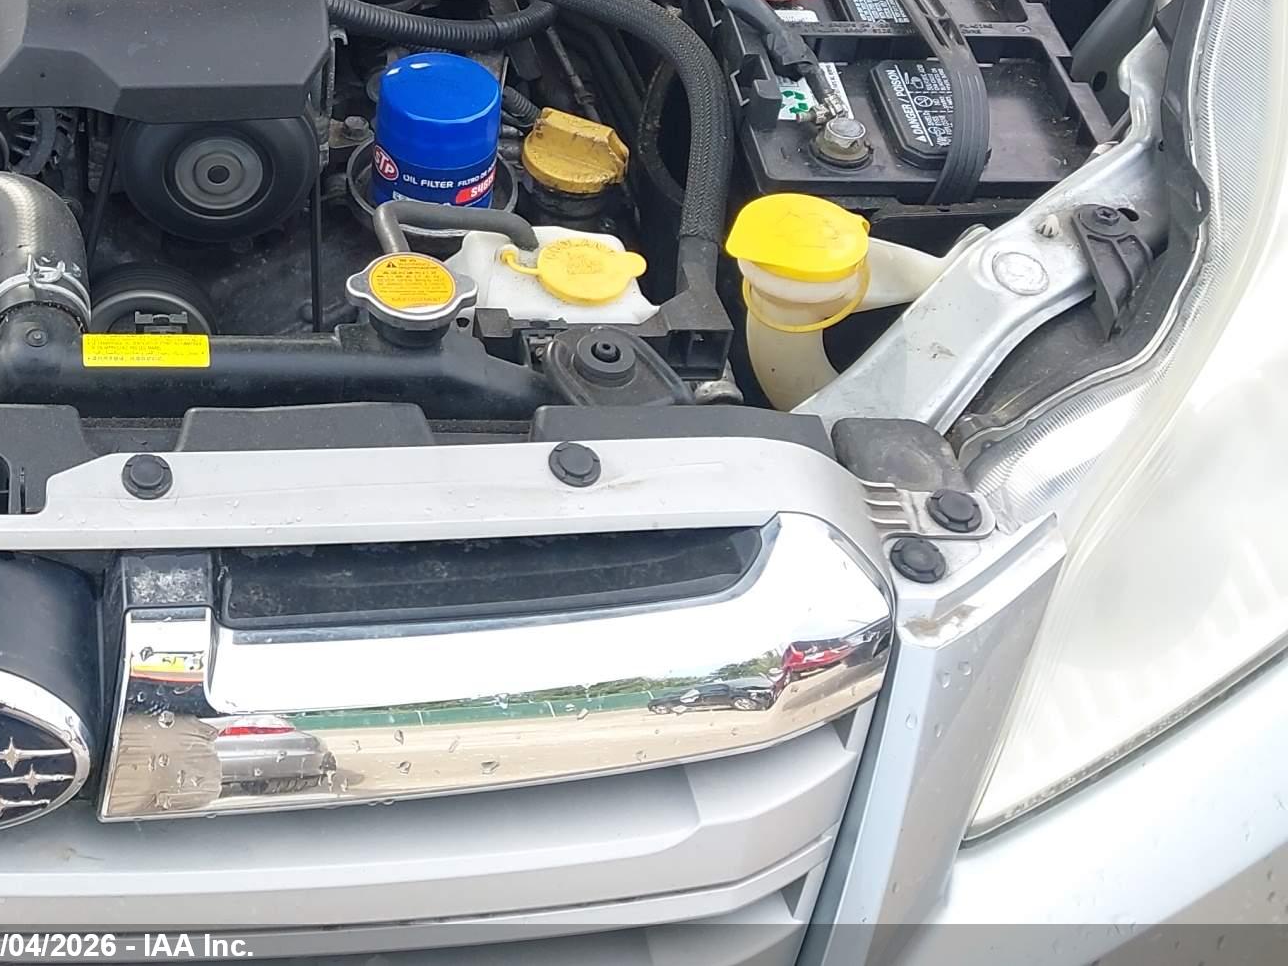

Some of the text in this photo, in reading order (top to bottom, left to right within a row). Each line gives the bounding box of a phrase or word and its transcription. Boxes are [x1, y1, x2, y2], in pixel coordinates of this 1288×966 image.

[885, 69, 907, 97] POISON
[901, 103, 925, 134] DANGER
[375, 151, 395, 175] STP
[402, 173, 418, 185] OIL
[420, 178, 453, 189] FILTER
